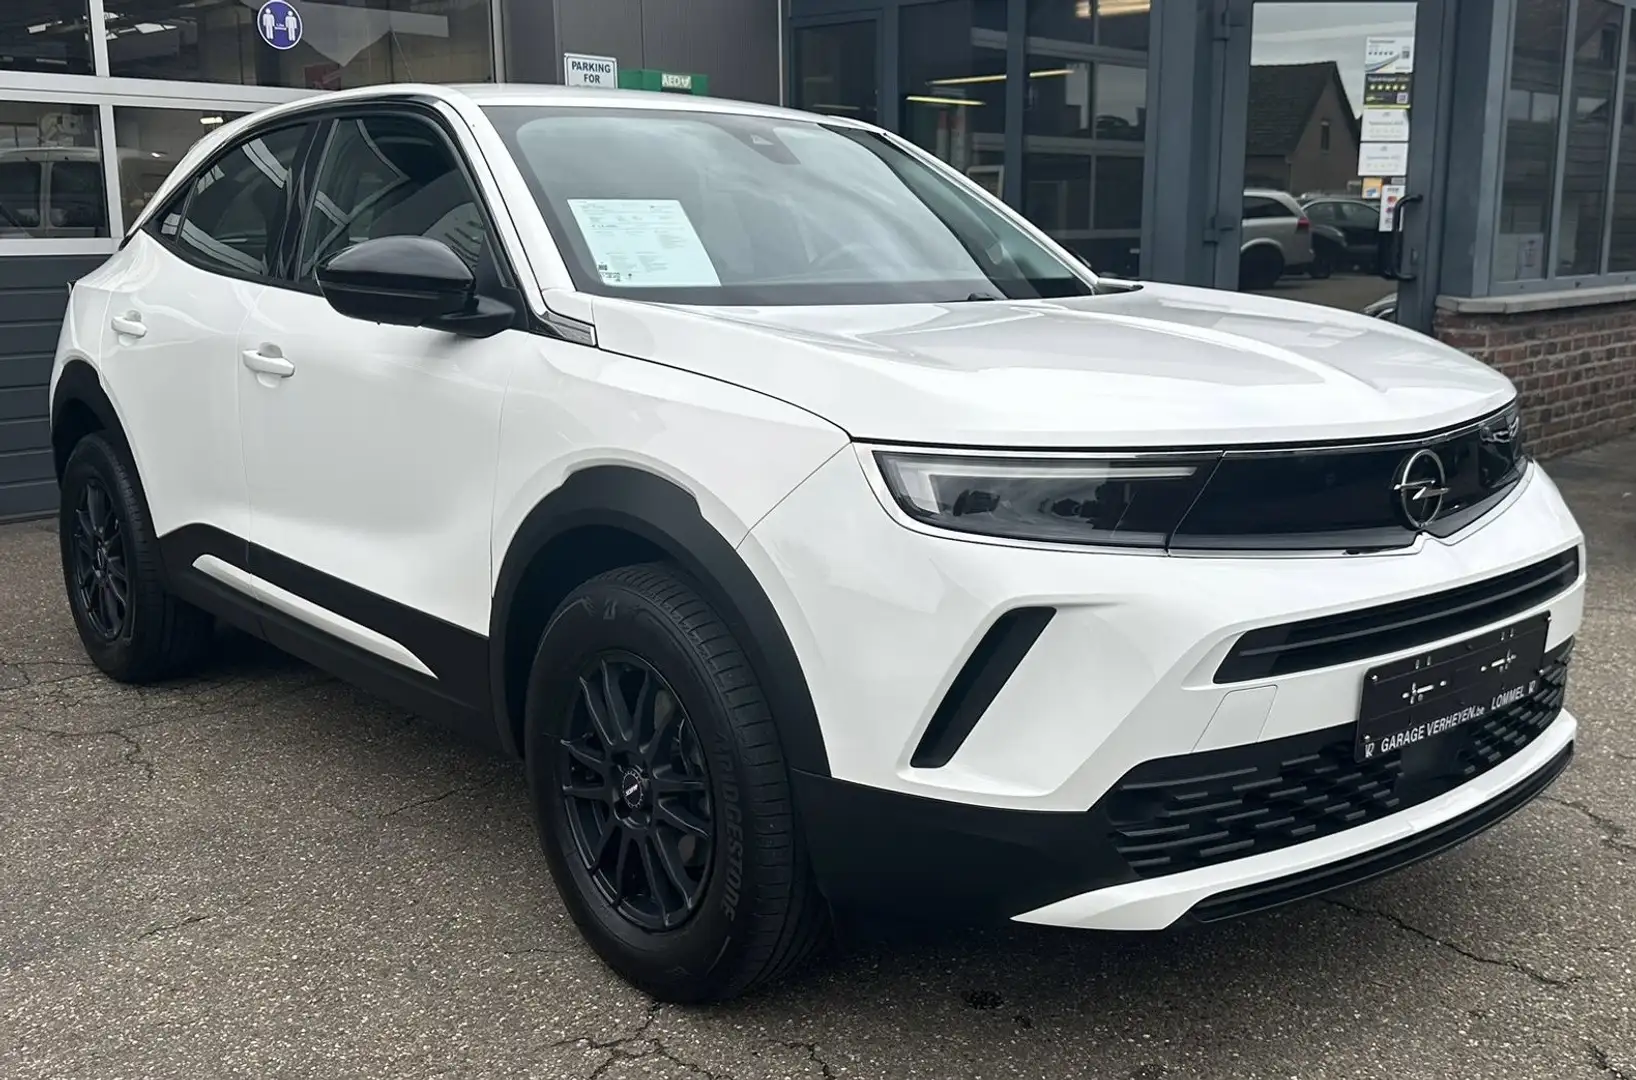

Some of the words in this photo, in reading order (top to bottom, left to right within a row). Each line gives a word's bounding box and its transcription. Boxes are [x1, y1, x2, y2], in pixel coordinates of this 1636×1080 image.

[571, 61, 611, 73] PARKING
[583, 73, 601, 84] FOR
[1381, 725, 1426, 753] GARAGE
[1426, 705, 1485, 737] VERHEYEN.be
[1491, 685, 1525, 711] LOMMEL
